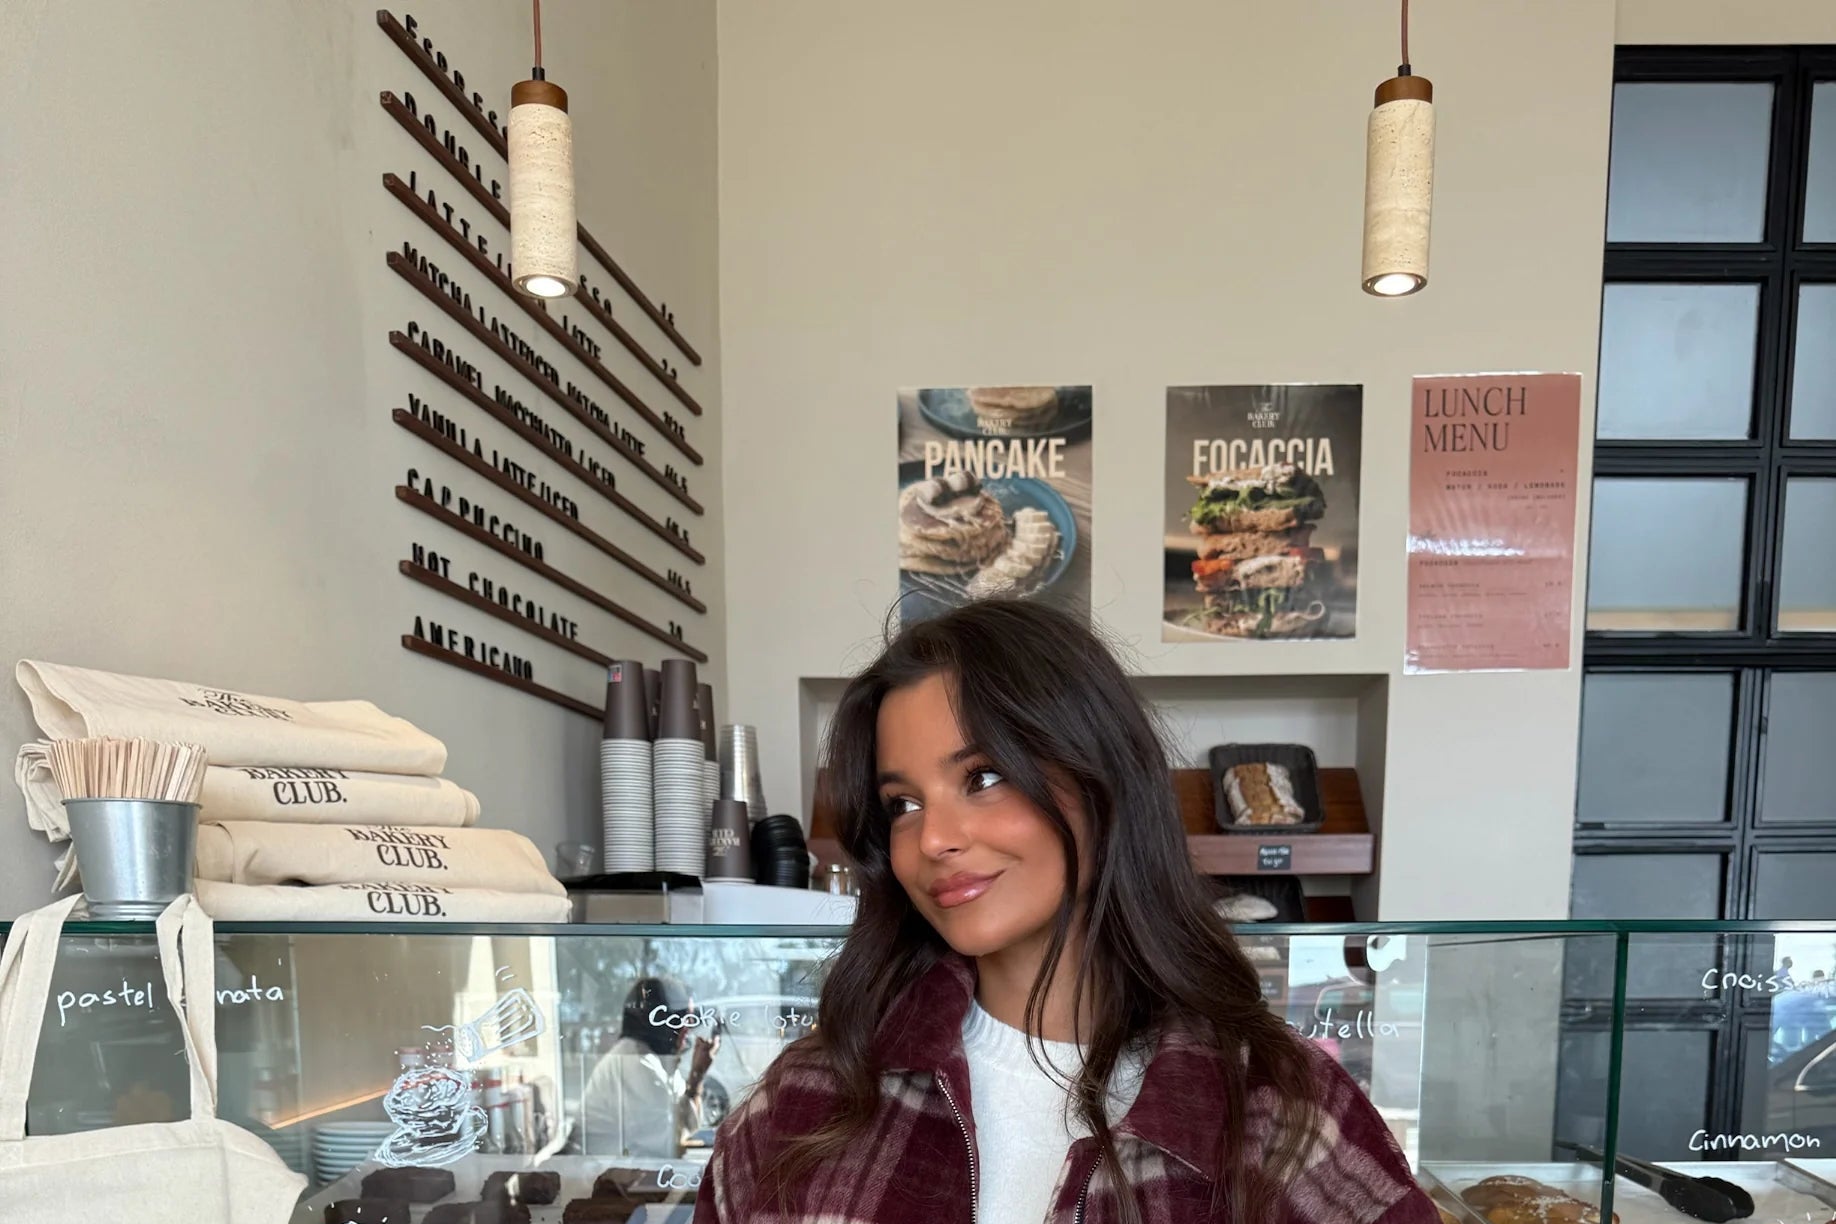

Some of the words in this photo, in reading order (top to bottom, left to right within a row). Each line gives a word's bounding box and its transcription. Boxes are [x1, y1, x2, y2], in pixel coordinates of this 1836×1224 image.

[408, 321, 482, 389] CARAMEL
[1424, 387, 1526, 418] LUNCH
[408, 393, 483, 459] VANILLA
[1424, 422, 1509, 452] MENU
[924, 438, 1066, 480] PANCAKE
[1193, 438, 1334, 477] FOCACCIA
[407, 468, 543, 563] CAPPUCCINO
[412, 543, 450, 580] HOT
[468, 571, 578, 642] CHOCOLATE
[414, 616, 533, 682] AMERICANO
[273, 780, 348, 805] CLUB.
[344, 827, 451, 850] BAKERY
[376, 843, 448, 871] CLUB.
[367, 891, 447, 918] CLUB.
[57, 977, 154, 1026] pastel
[216, 975, 284, 1005] nata
[648, 1003, 741, 1029] Cookie
[1689, 1129, 1821, 1152] Cinnamon
